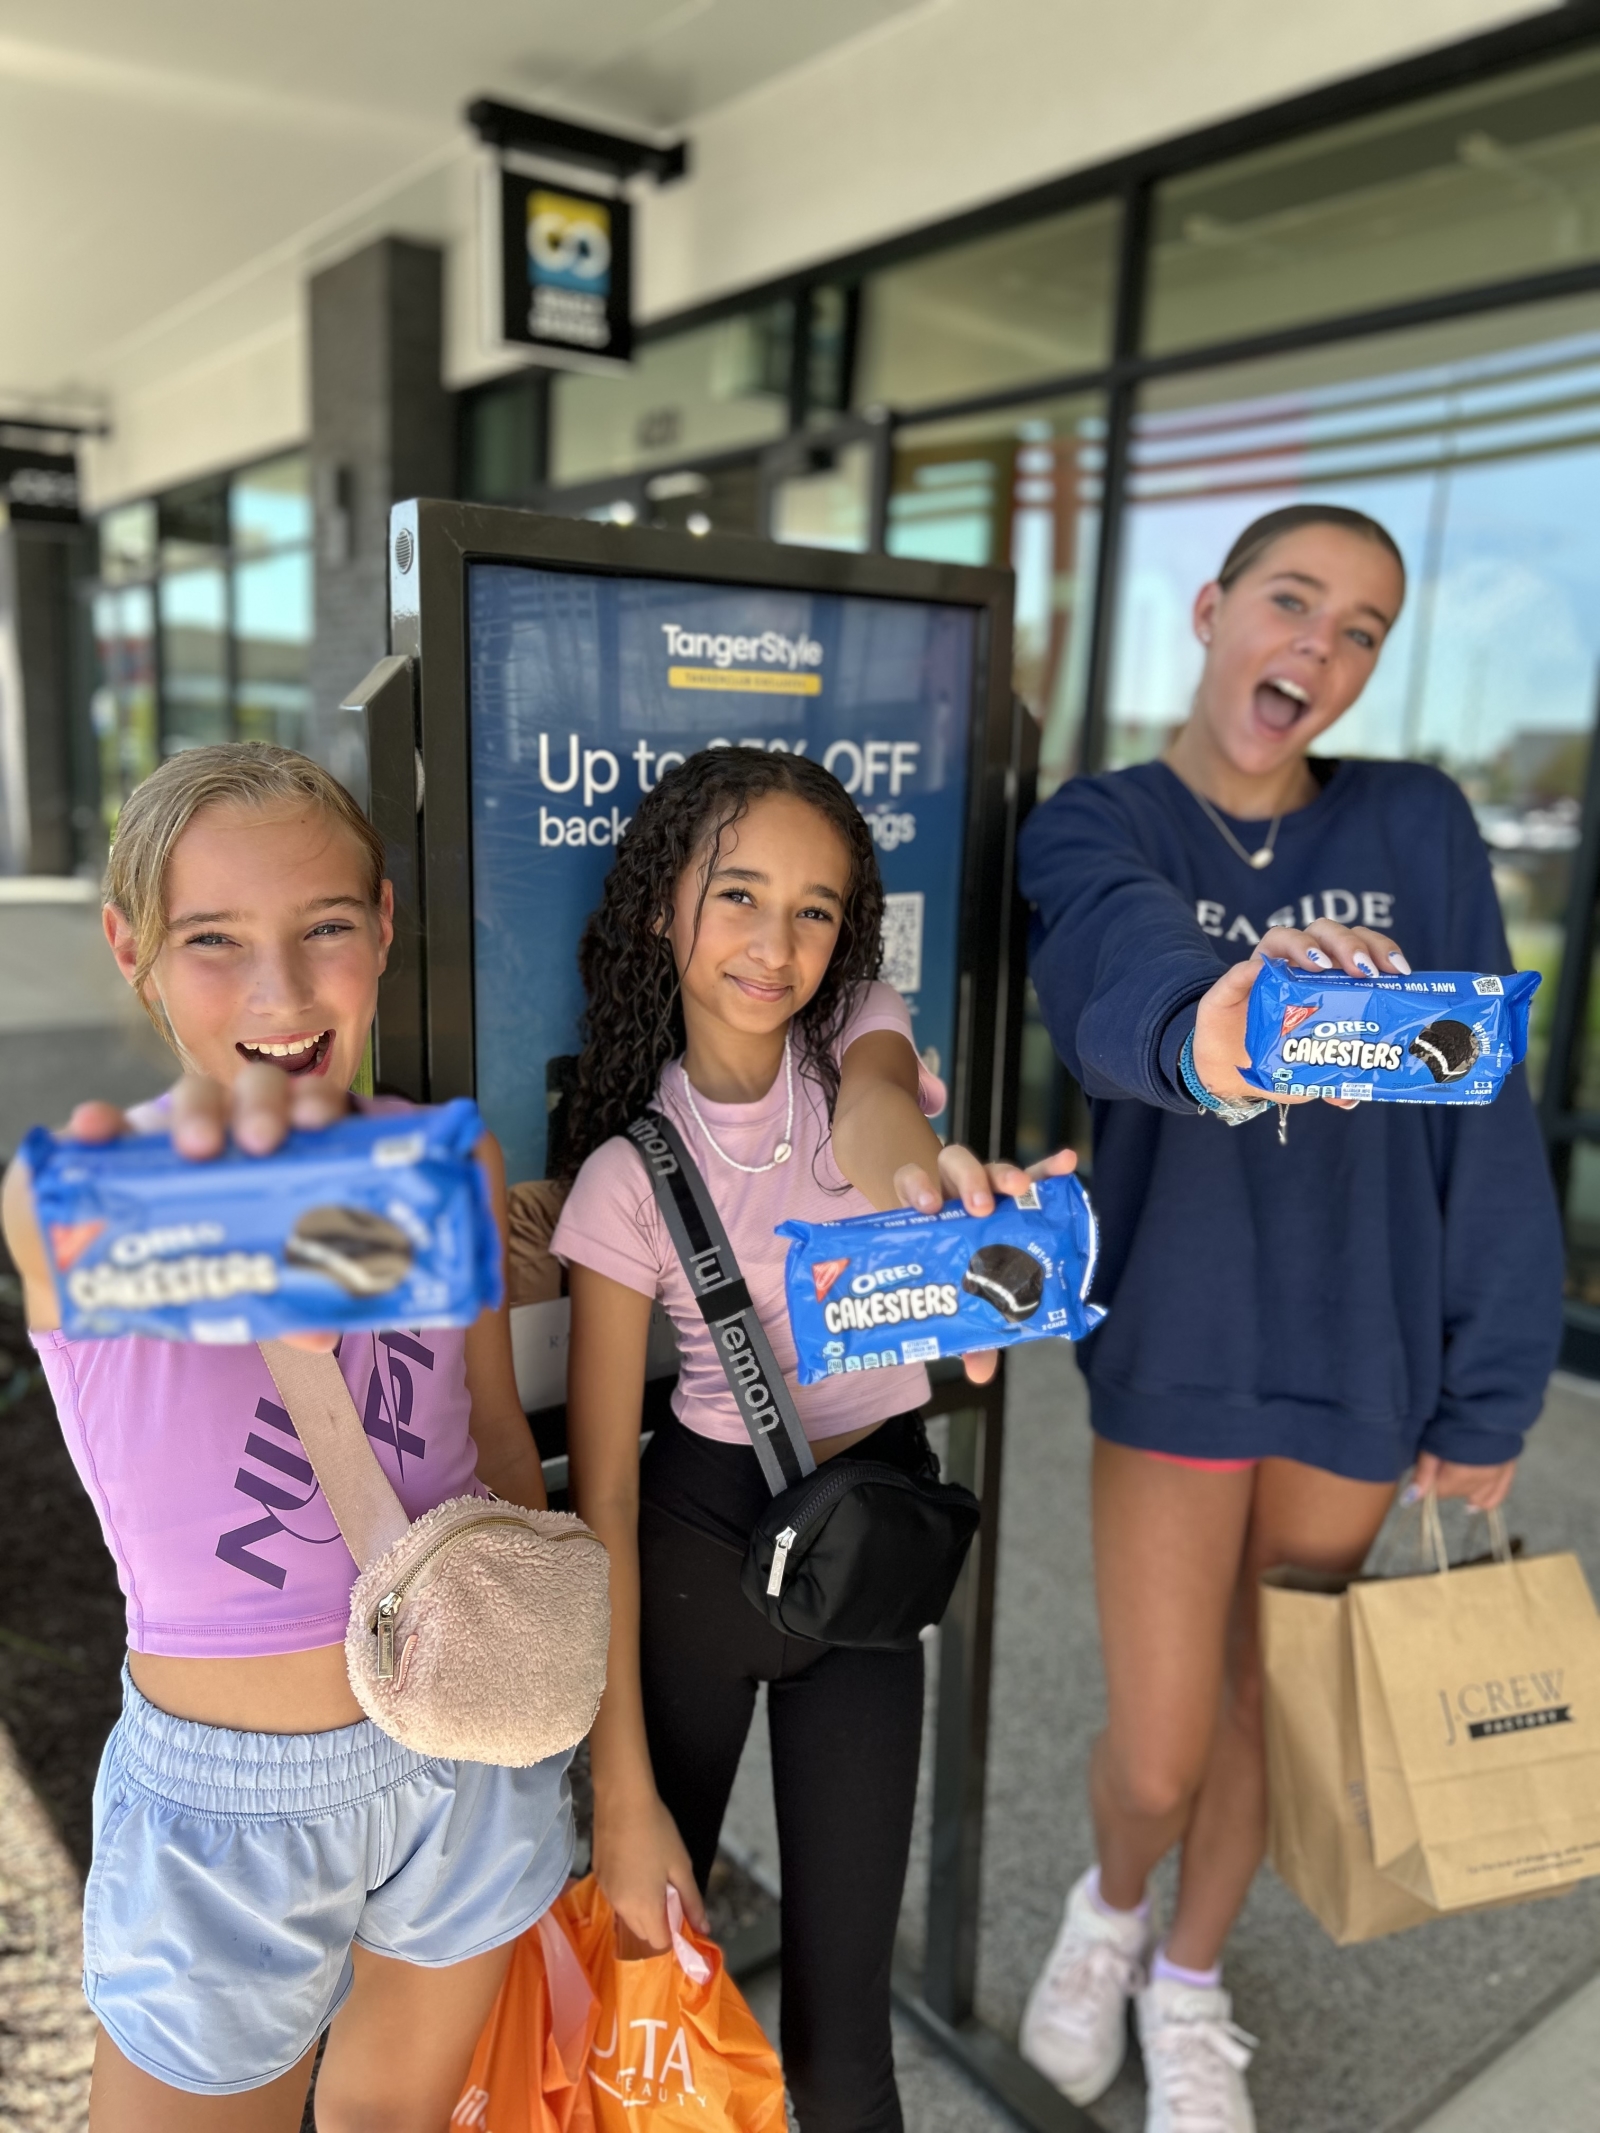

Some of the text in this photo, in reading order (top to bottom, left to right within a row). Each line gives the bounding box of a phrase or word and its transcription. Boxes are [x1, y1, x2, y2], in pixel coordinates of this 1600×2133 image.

[661, 623, 824, 671] TangerStyle
[538, 732, 620, 807] Up
[823, 740, 921, 796] OFF
[1403, 981, 1429, 992] YOUR
[1432, 982, 1456, 993] HAVE
[1314, 1021, 1380, 1038] OREO
[1283, 1037, 1403, 1071] CAKESTERS
[852, 1263, 923, 1294] OREO
[824, 1284, 958, 1334] CAKESTERS
